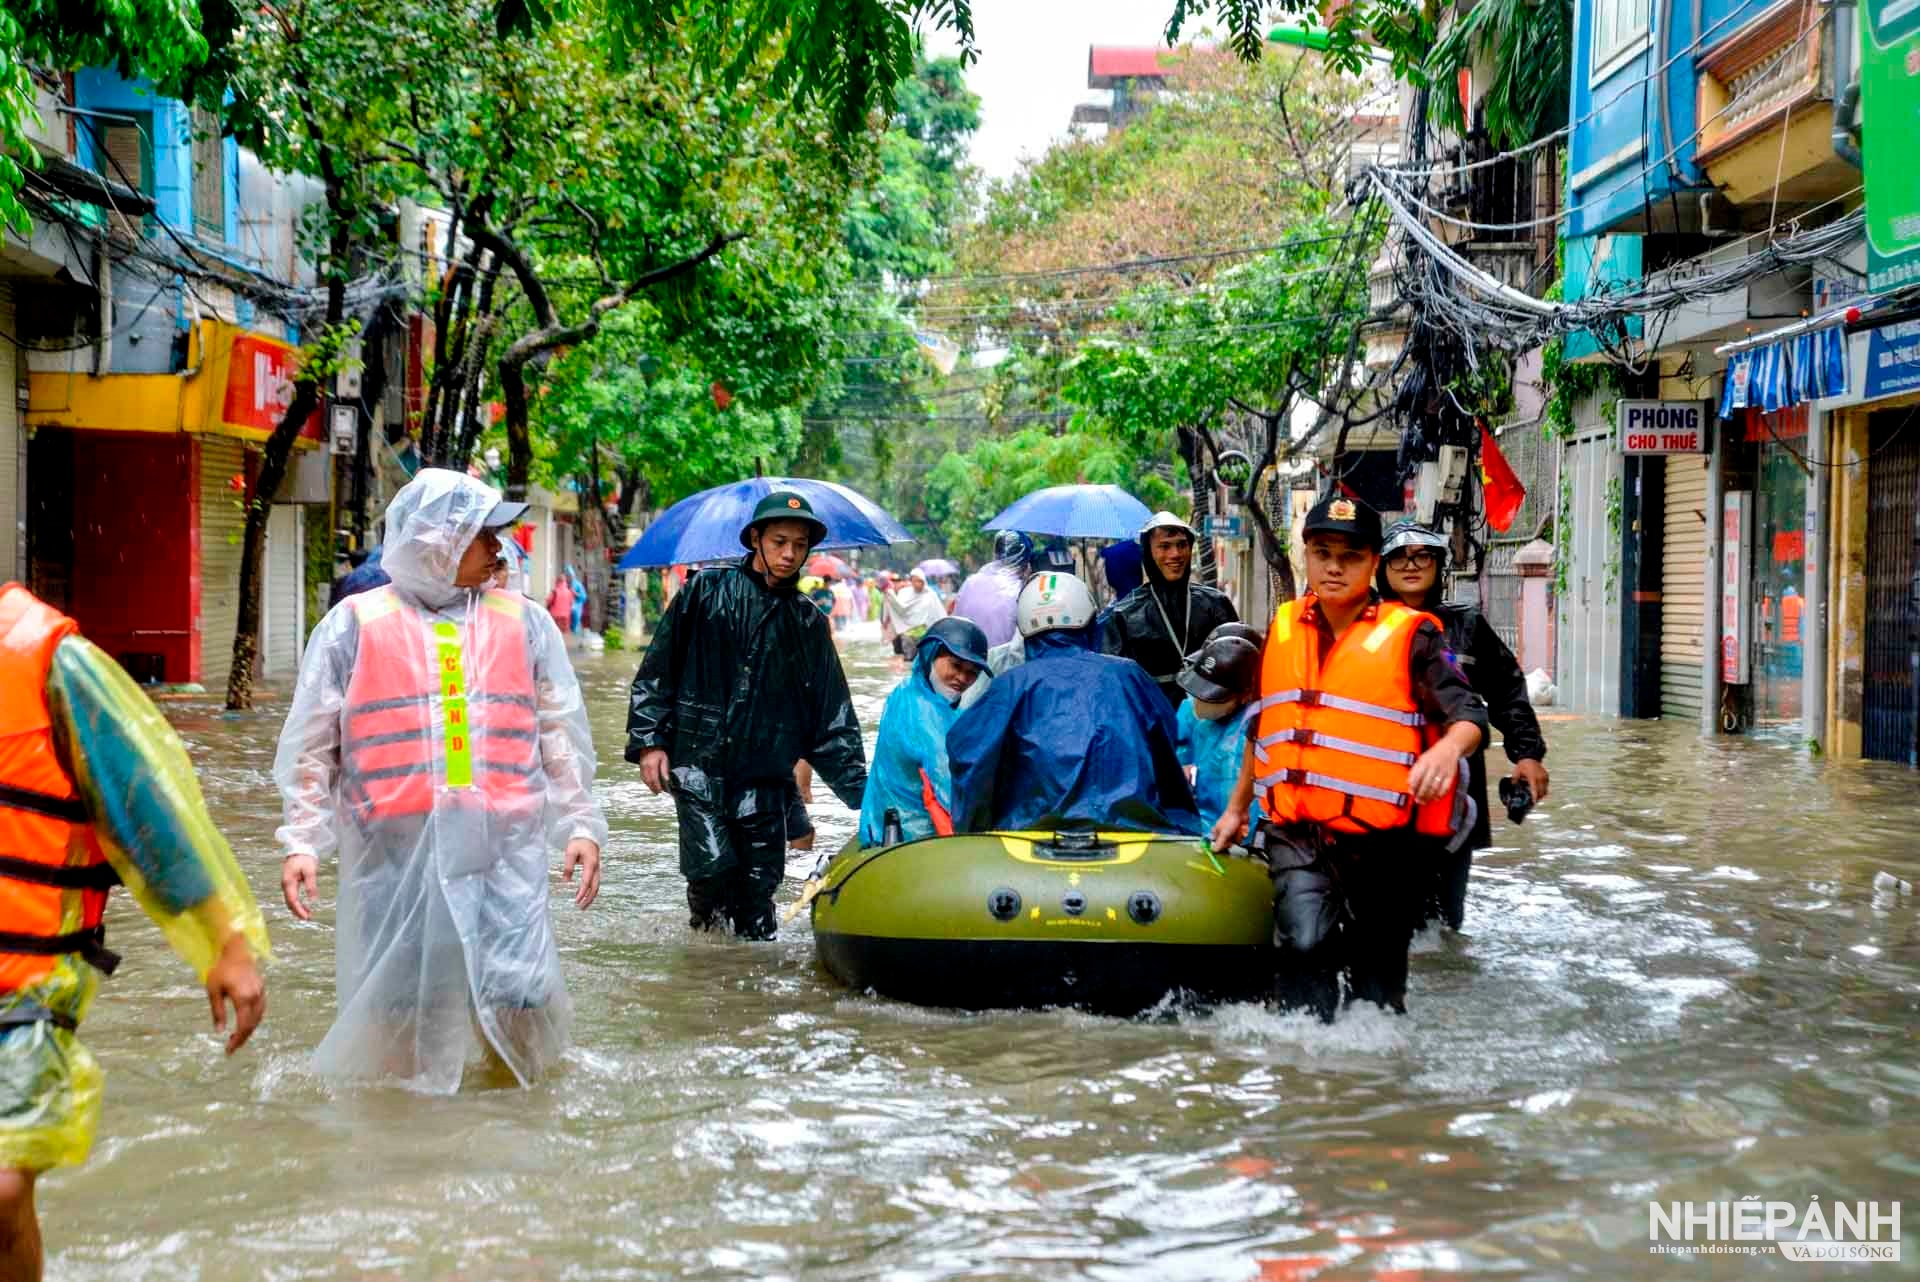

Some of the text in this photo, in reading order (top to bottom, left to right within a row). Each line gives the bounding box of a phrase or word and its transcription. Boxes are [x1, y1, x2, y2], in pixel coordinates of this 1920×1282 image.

[1628, 432, 1697, 449] CHO THUÊ
[444, 656, 464, 752] CAND
